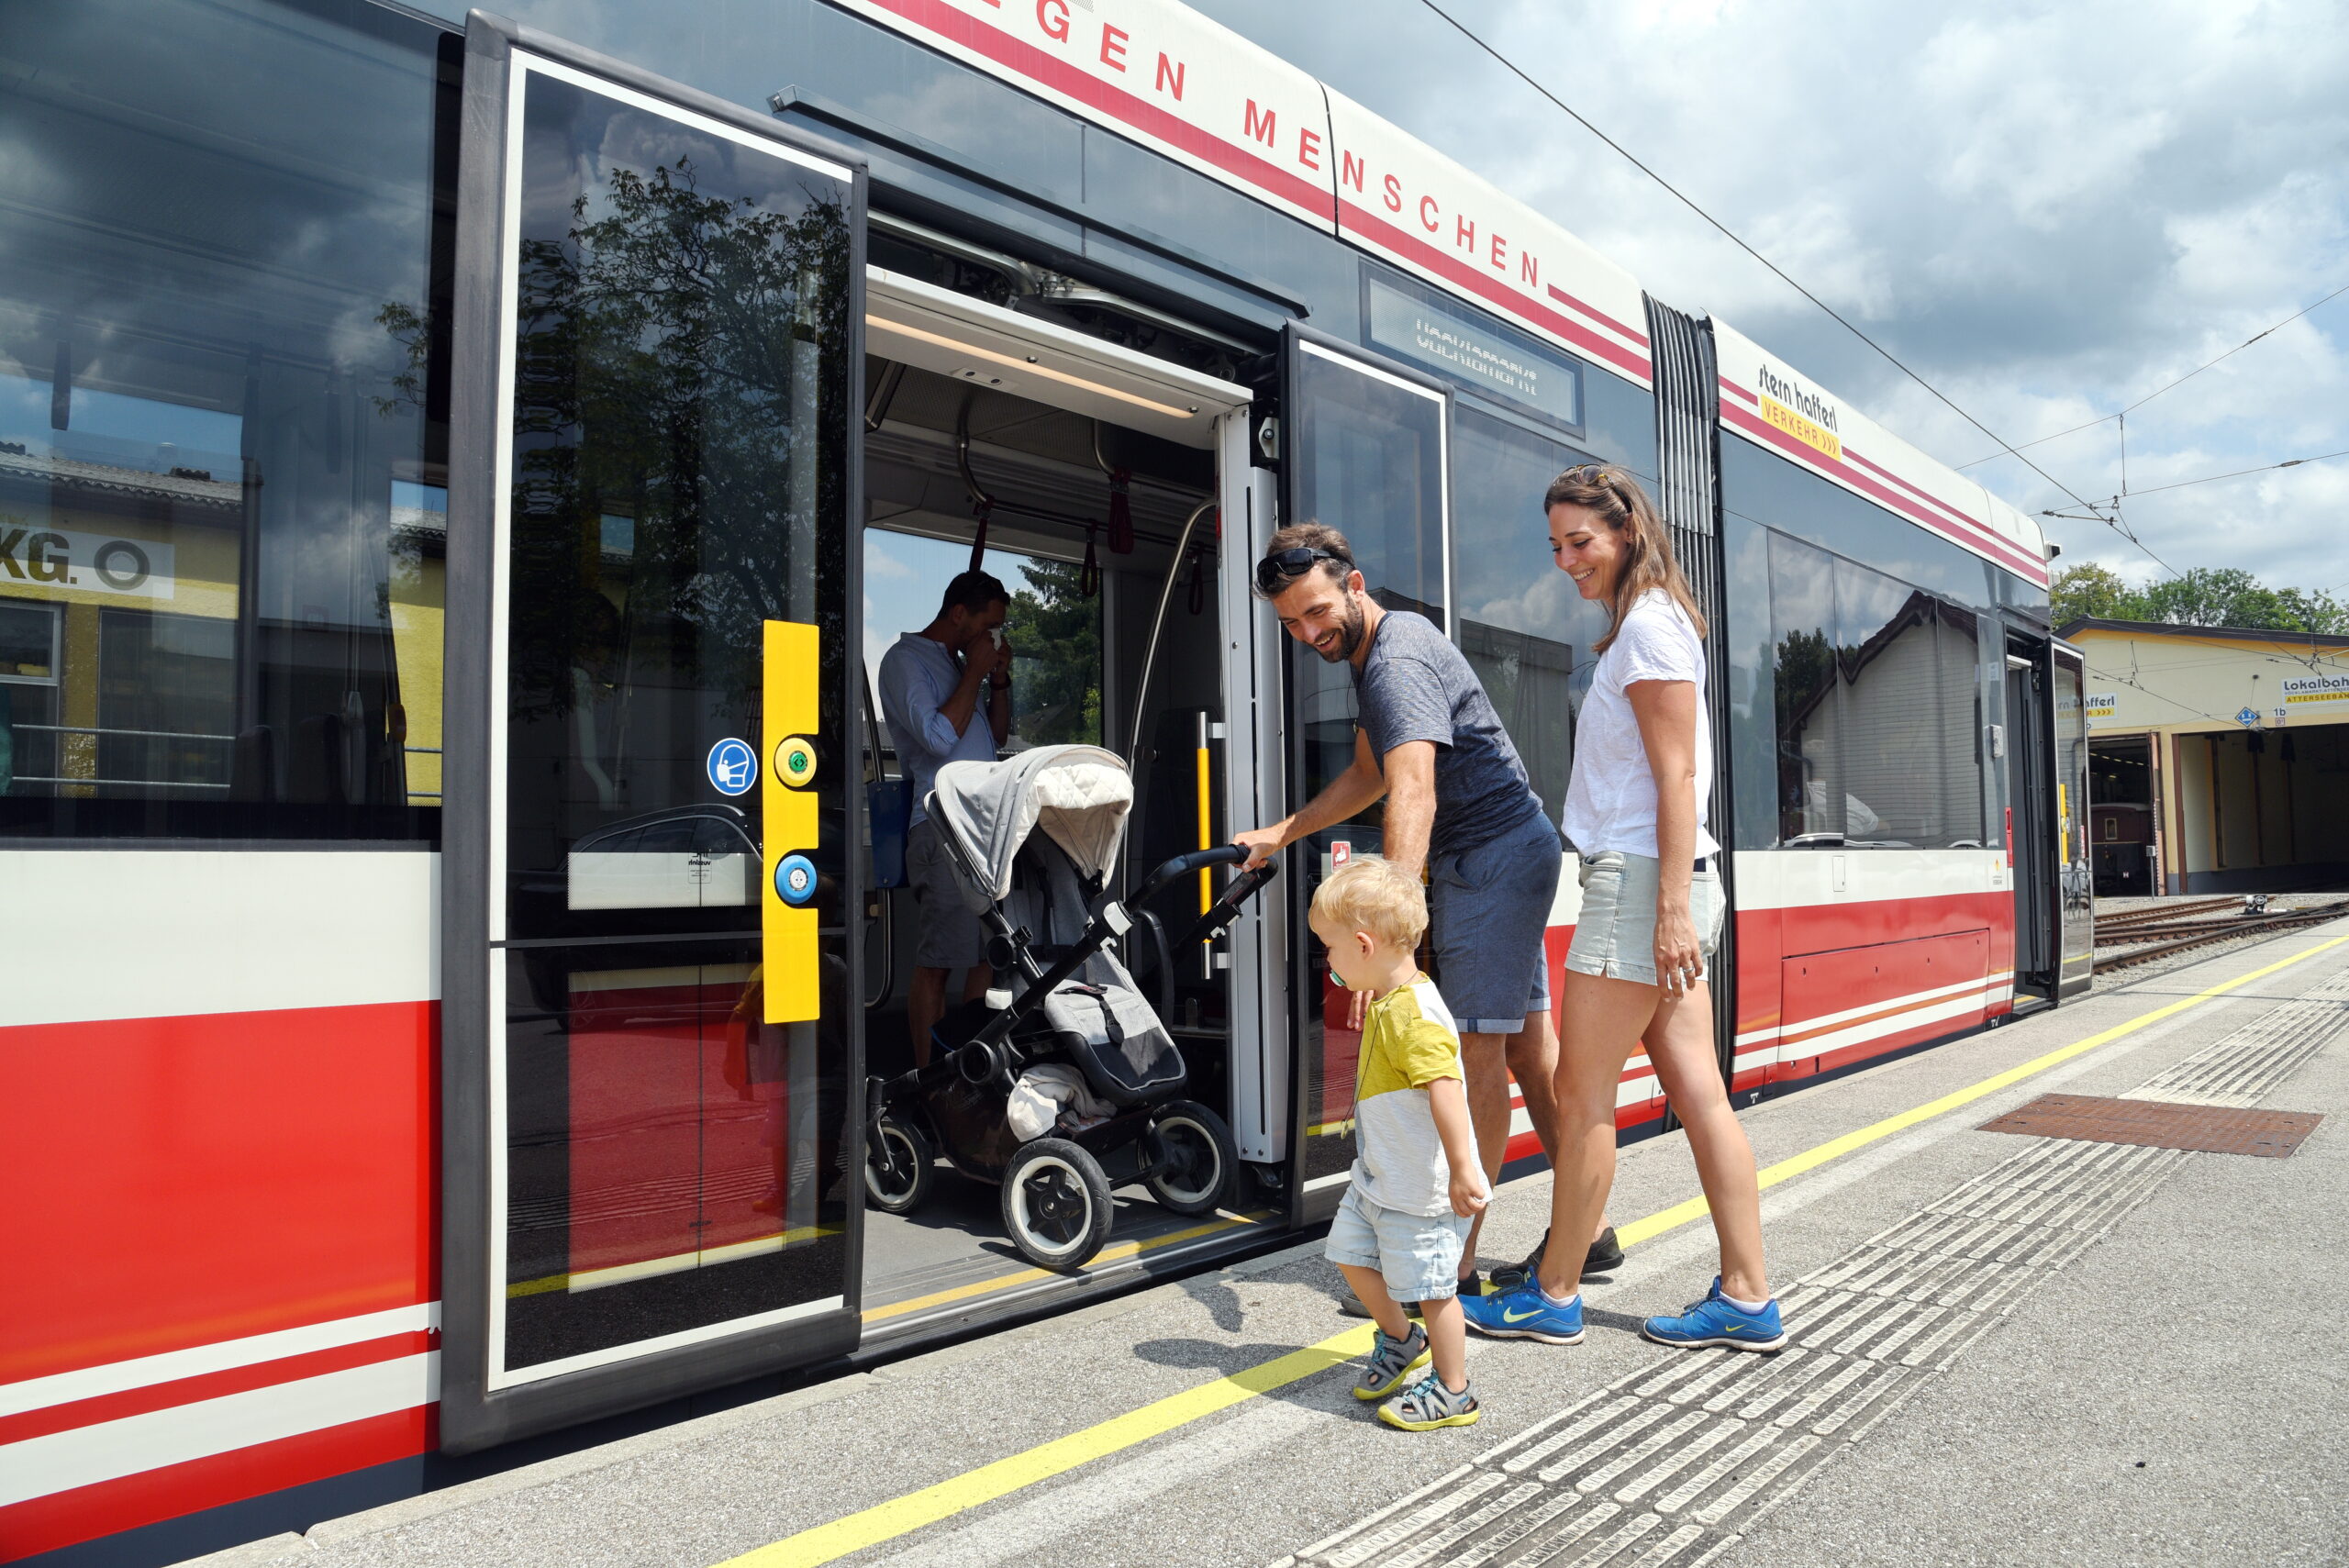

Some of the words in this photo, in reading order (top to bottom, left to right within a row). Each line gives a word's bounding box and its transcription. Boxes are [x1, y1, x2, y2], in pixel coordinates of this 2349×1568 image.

[982, 0, 1185, 102] GEN
[1243, 97, 1538, 288] MENSCHEN
[1758, 363, 1792, 406] stern
[1794, 382, 1838, 433] hafferl
[1765, 401, 1819, 445] VERKEHR
[2273, 707, 2286, 717] 1b
